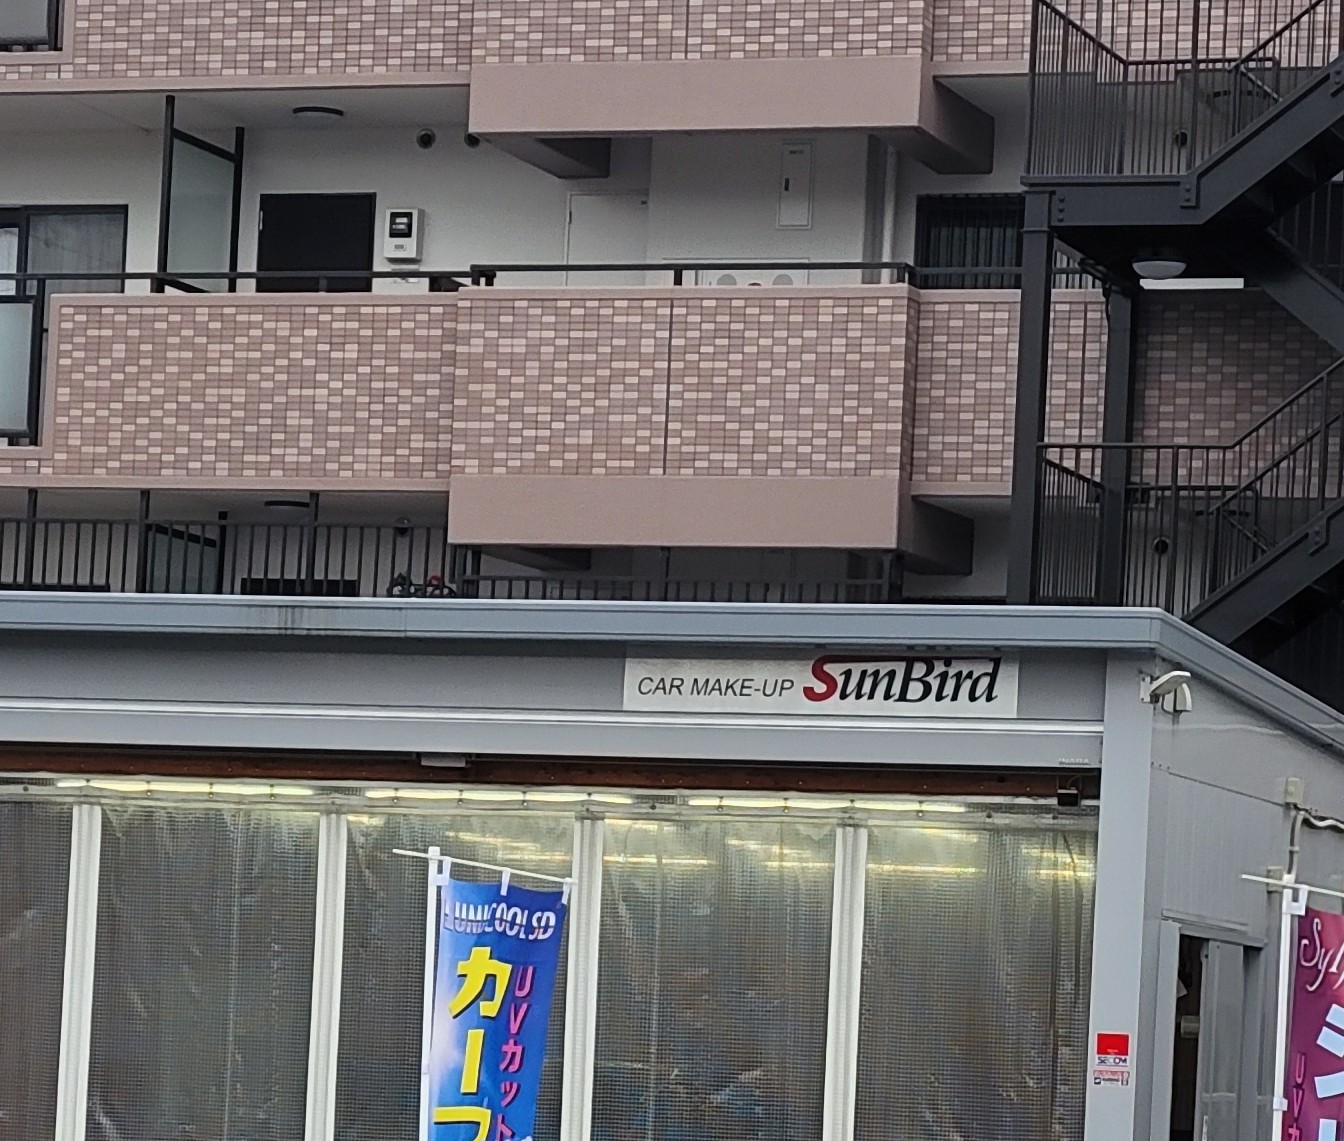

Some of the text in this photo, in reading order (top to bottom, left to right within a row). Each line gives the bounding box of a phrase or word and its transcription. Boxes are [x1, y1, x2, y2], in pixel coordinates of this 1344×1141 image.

[638, 655, 1002, 703] CAR MAKE-UP SunBird
